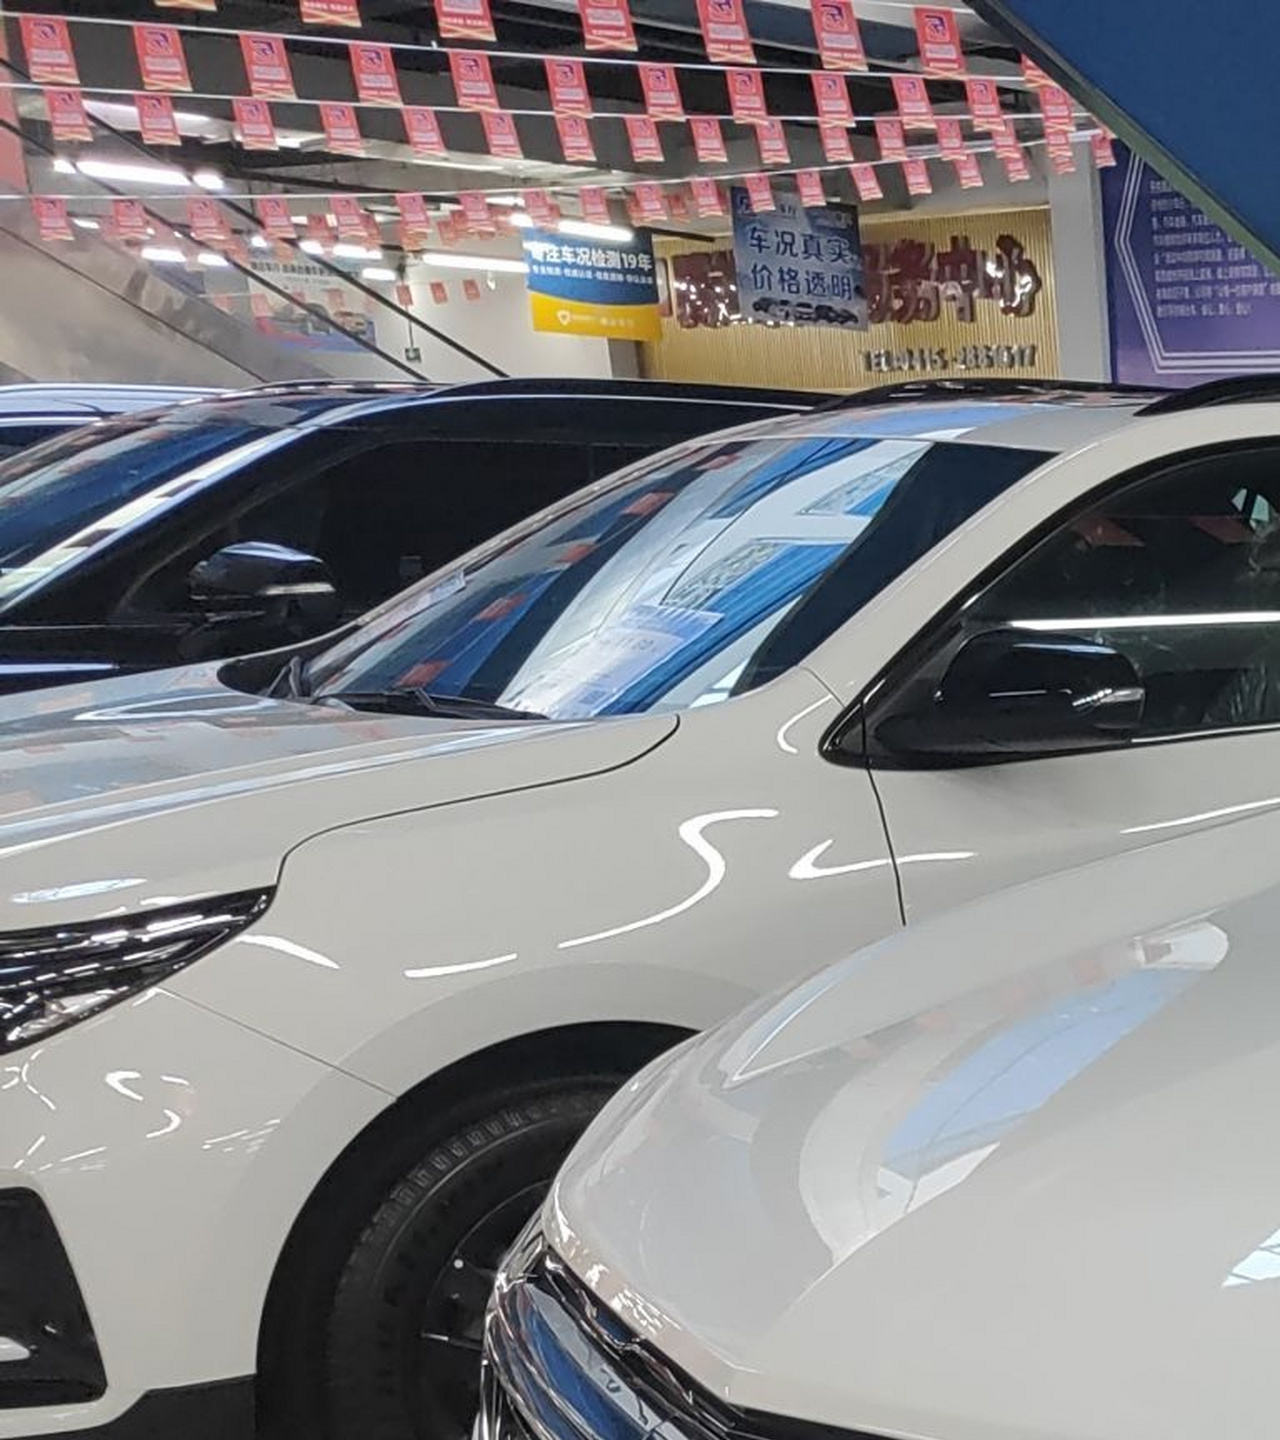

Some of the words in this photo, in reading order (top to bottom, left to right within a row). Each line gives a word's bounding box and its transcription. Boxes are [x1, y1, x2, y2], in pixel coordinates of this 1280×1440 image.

[750, 226, 850, 264] 车况真实
[751, 262, 853, 300] 价格透明
